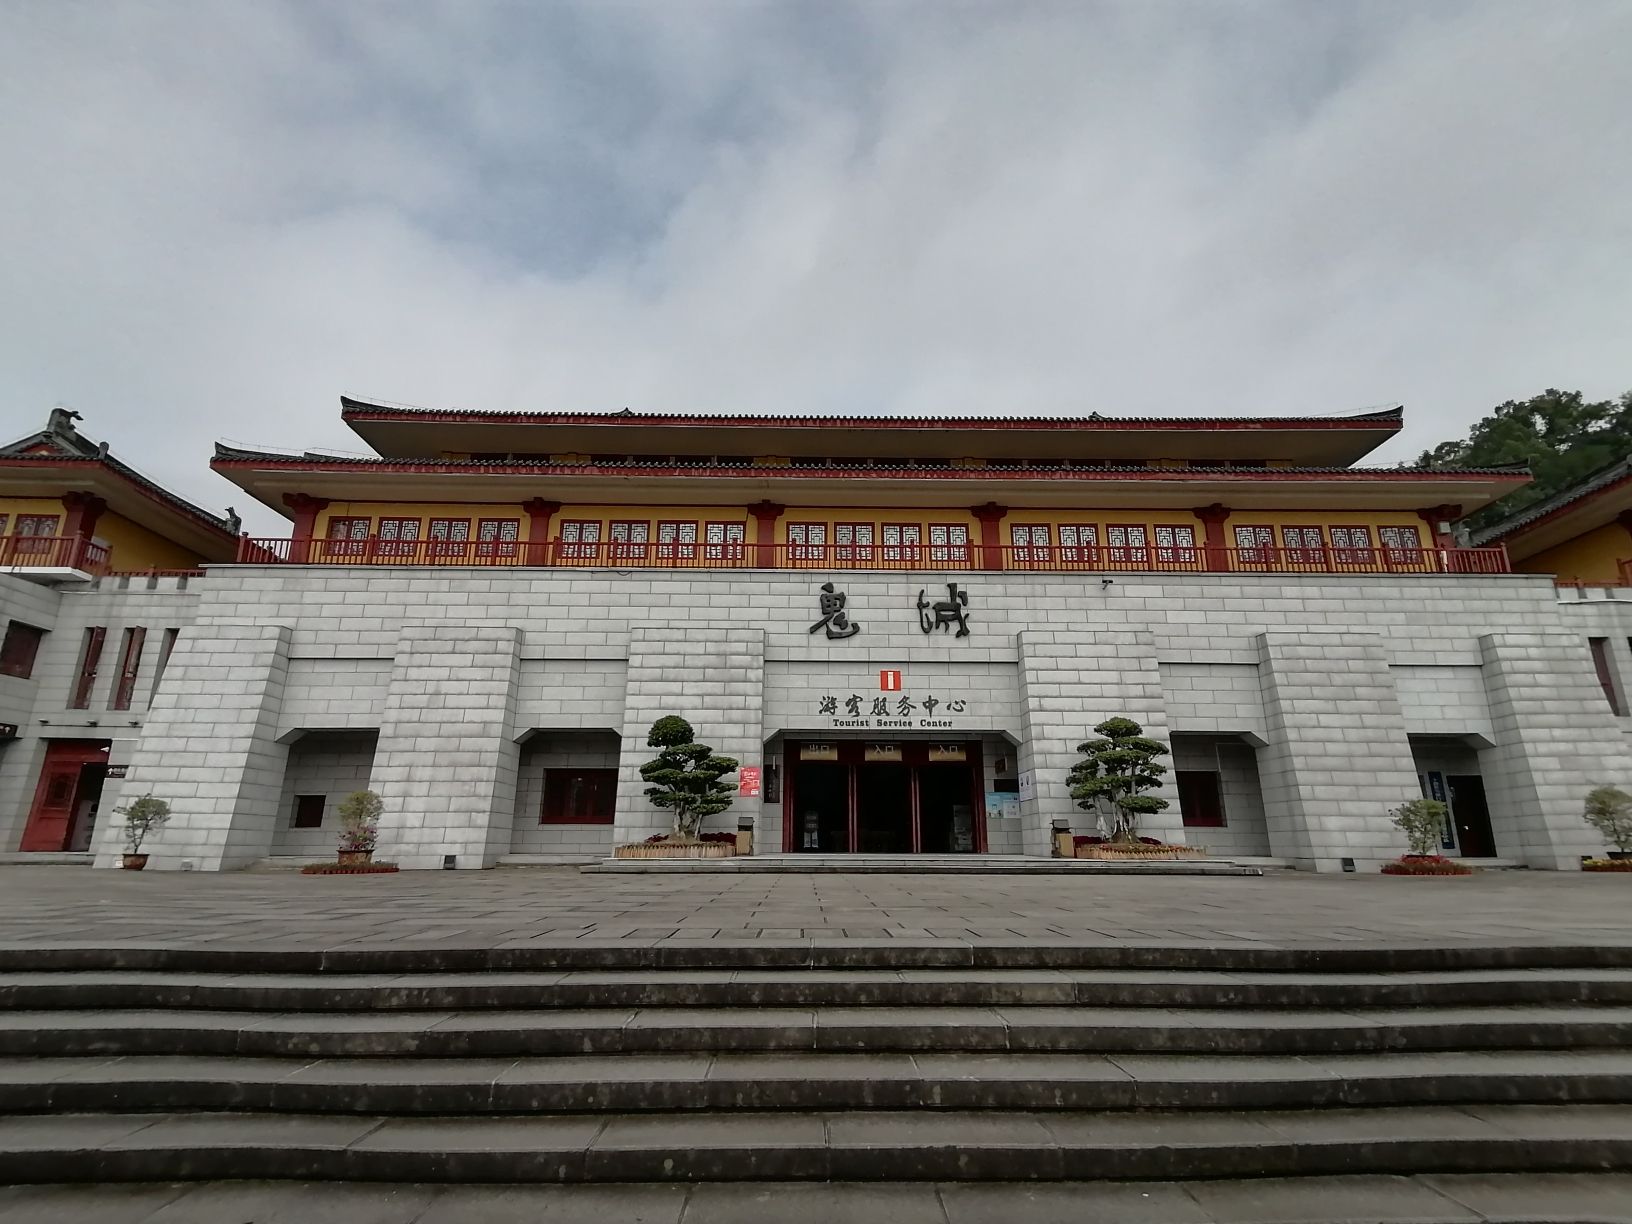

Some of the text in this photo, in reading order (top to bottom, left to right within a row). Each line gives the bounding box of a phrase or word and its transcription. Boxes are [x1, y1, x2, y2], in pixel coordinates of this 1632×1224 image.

[819, 694, 967, 718] 游客服务中心
[833, 719, 953, 728] Tourist Service Center
[809, 743, 828, 754] 出口
[875, 744, 894, 754] 入口
[939, 744, 958, 754] 入口
